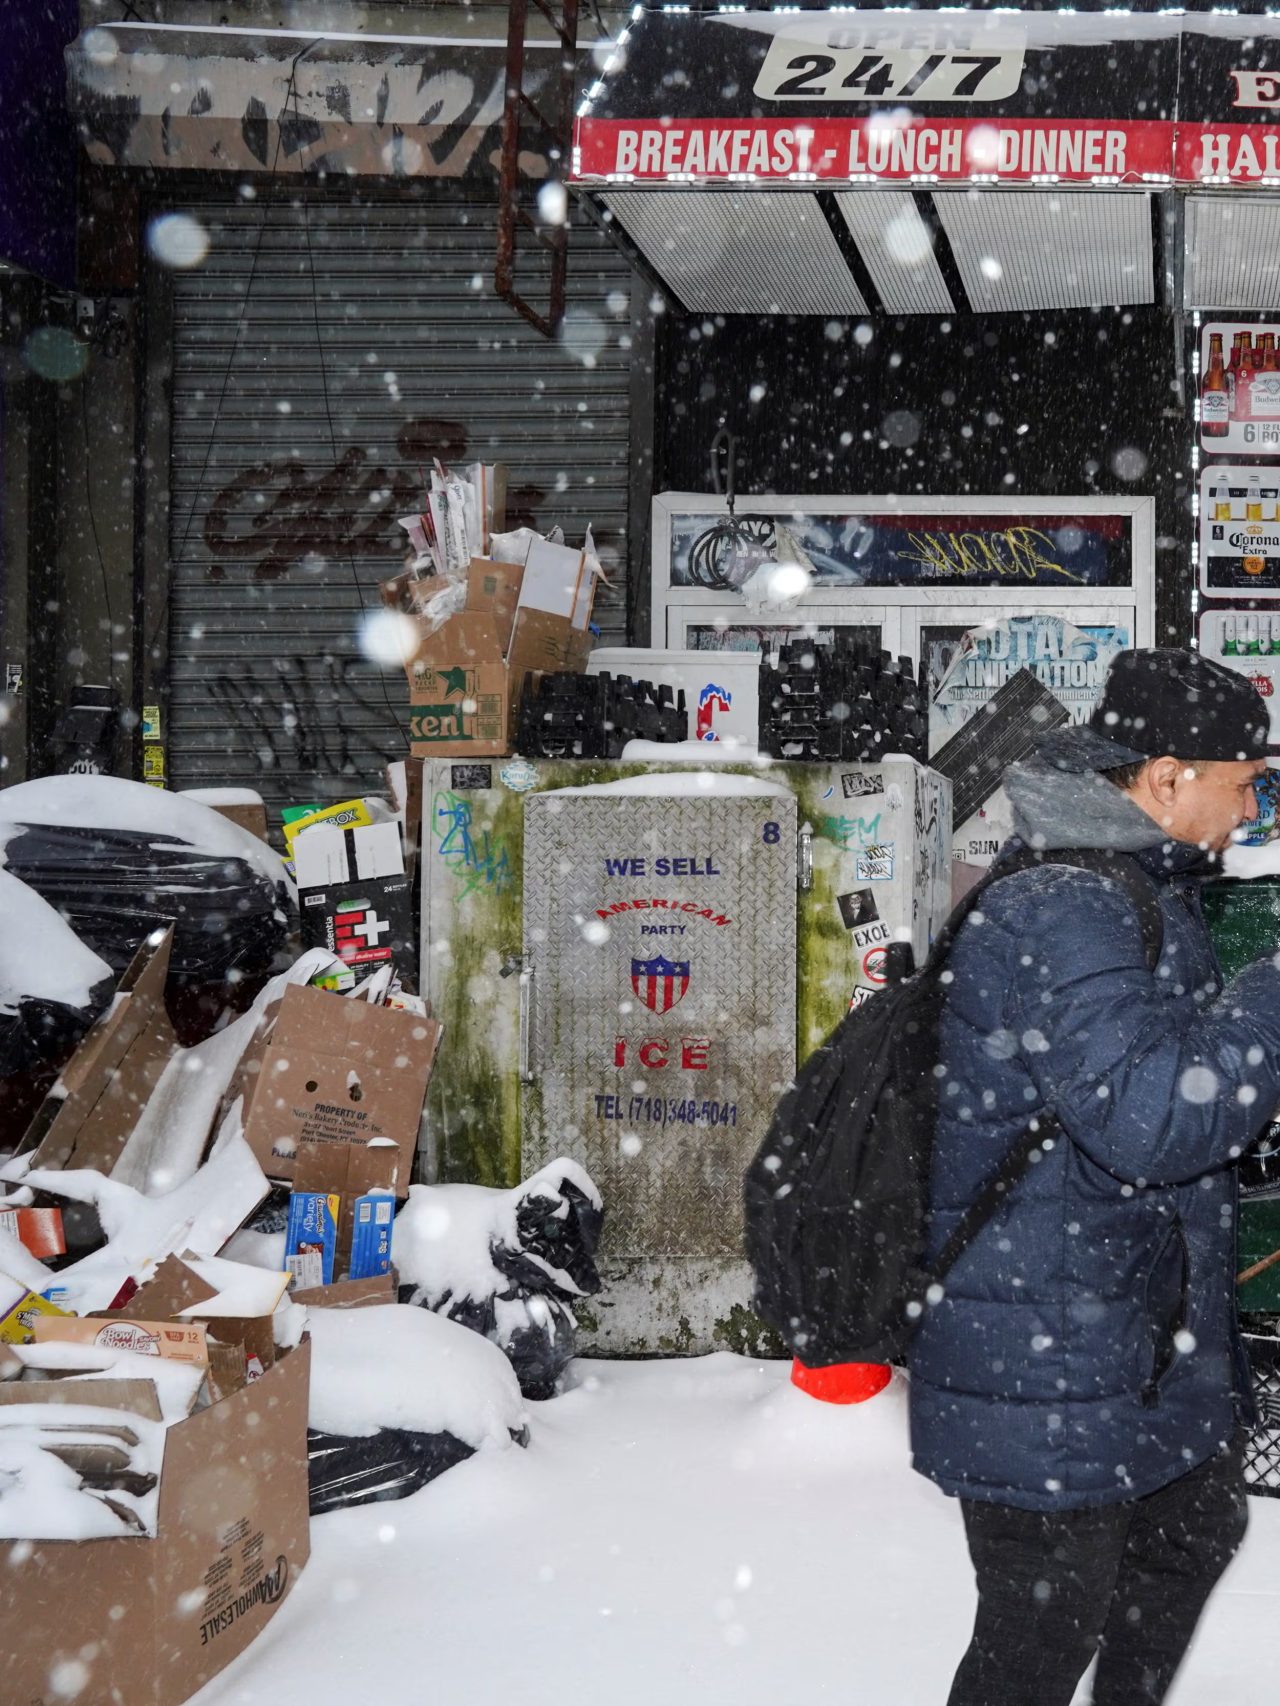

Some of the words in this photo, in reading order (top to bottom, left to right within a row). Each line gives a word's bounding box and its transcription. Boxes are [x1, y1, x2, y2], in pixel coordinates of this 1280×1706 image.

[774, 55, 1001, 96] 24/7
[615, 129, 814, 173] BREAKFAST
[849, 130, 960, 172] LUNCH
[999, 131, 1126, 173] DINNER
[1244, 424, 1255, 443] 6
[1229, 532, 1280, 549] Corona
[1242, 546, 1267, 555] Extra
[989, 622, 1083, 660] OTAL
[762, 822, 781, 844] 8
[968, 840, 999, 855] SUN
[606, 858, 645, 876] WE
[655, 857, 720, 876] SELL
[595, 899, 734, 926] AMERICAN
[326, 916, 335, 952] essentia
[641, 925, 686, 935] PARTY
[614, 1036, 712, 1070] ICE
[315, 1103, 355, 1118] PROPERTY
[357, 1111, 368, 1120] OF
[595, 1095, 623, 1121] TEL
[628, 1096, 737, 1128] (718)348-5041
[304, 1197, 316, 1232] variety
[101, 1339, 150, 1351] Noodles
[104, 1329, 136, 1342] Bowl
[187, 1332, 198, 1340] 12
